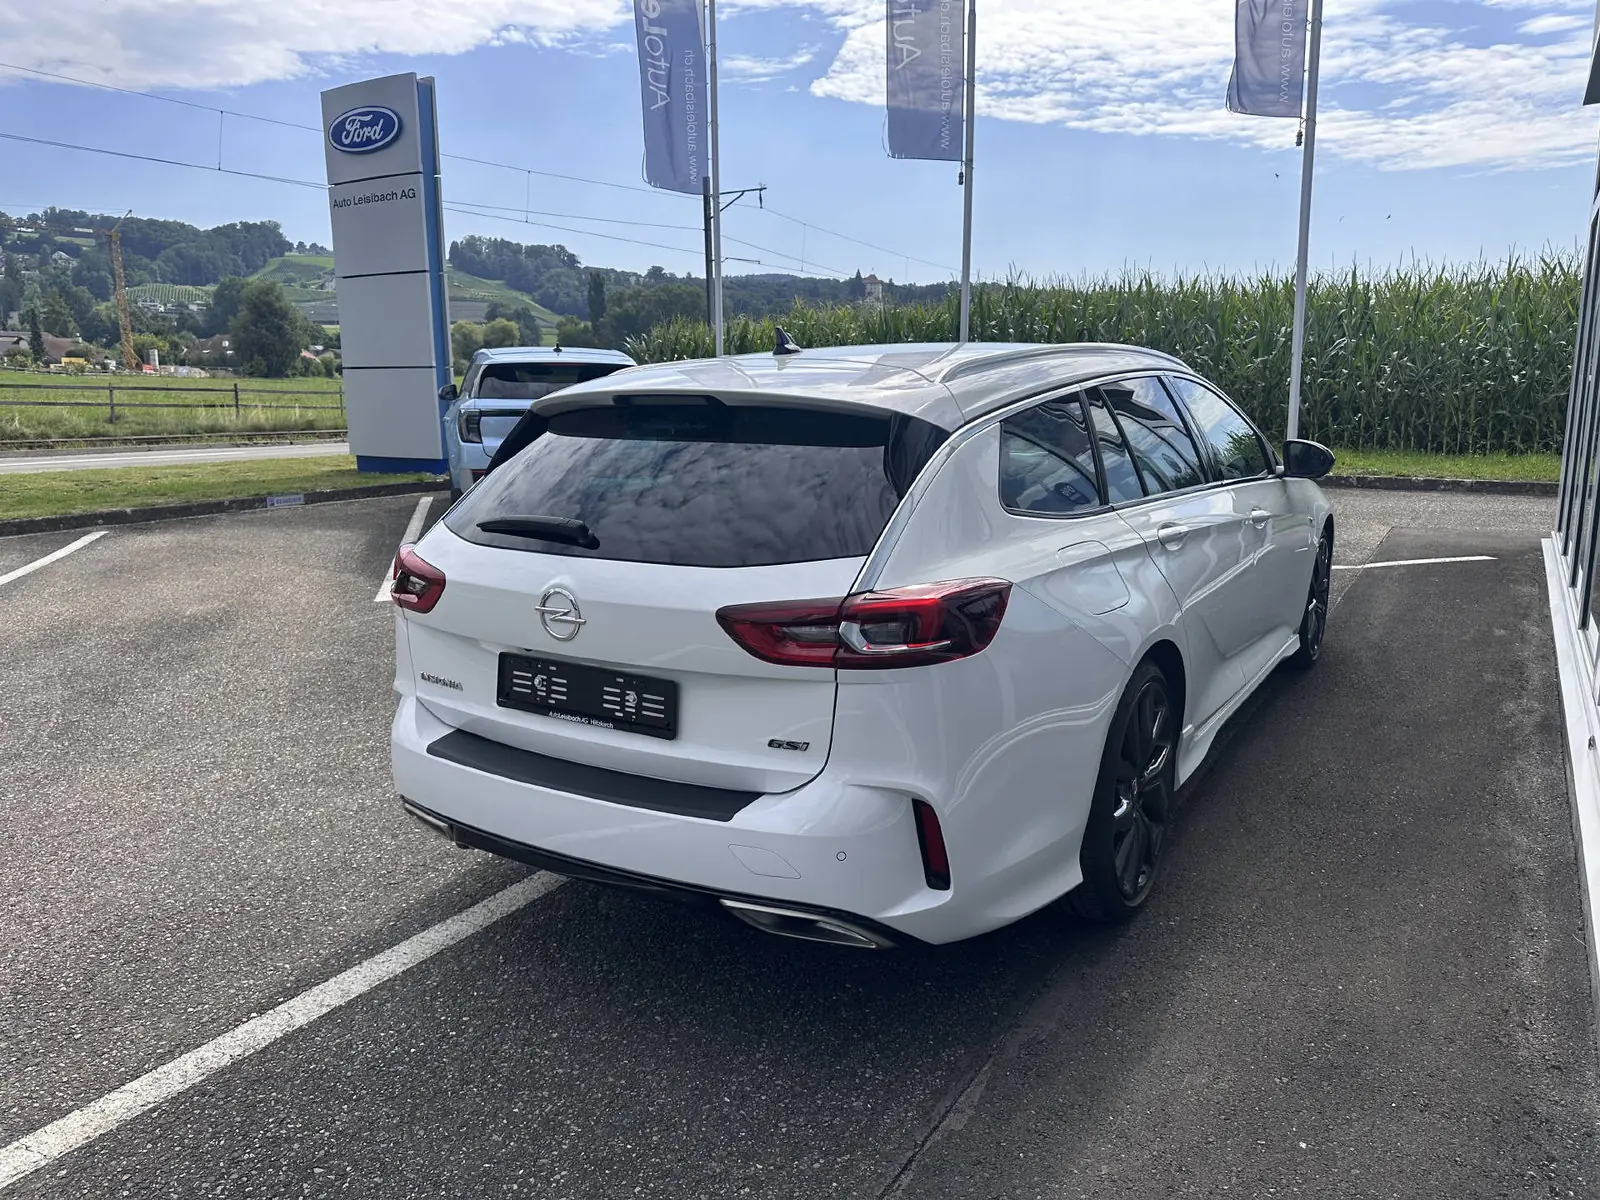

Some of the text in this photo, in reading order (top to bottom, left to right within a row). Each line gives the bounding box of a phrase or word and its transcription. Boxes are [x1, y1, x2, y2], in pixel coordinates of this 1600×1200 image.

[341, 114, 385, 145] Ford
[333, 188, 417, 209] Auto Leisibach AG
